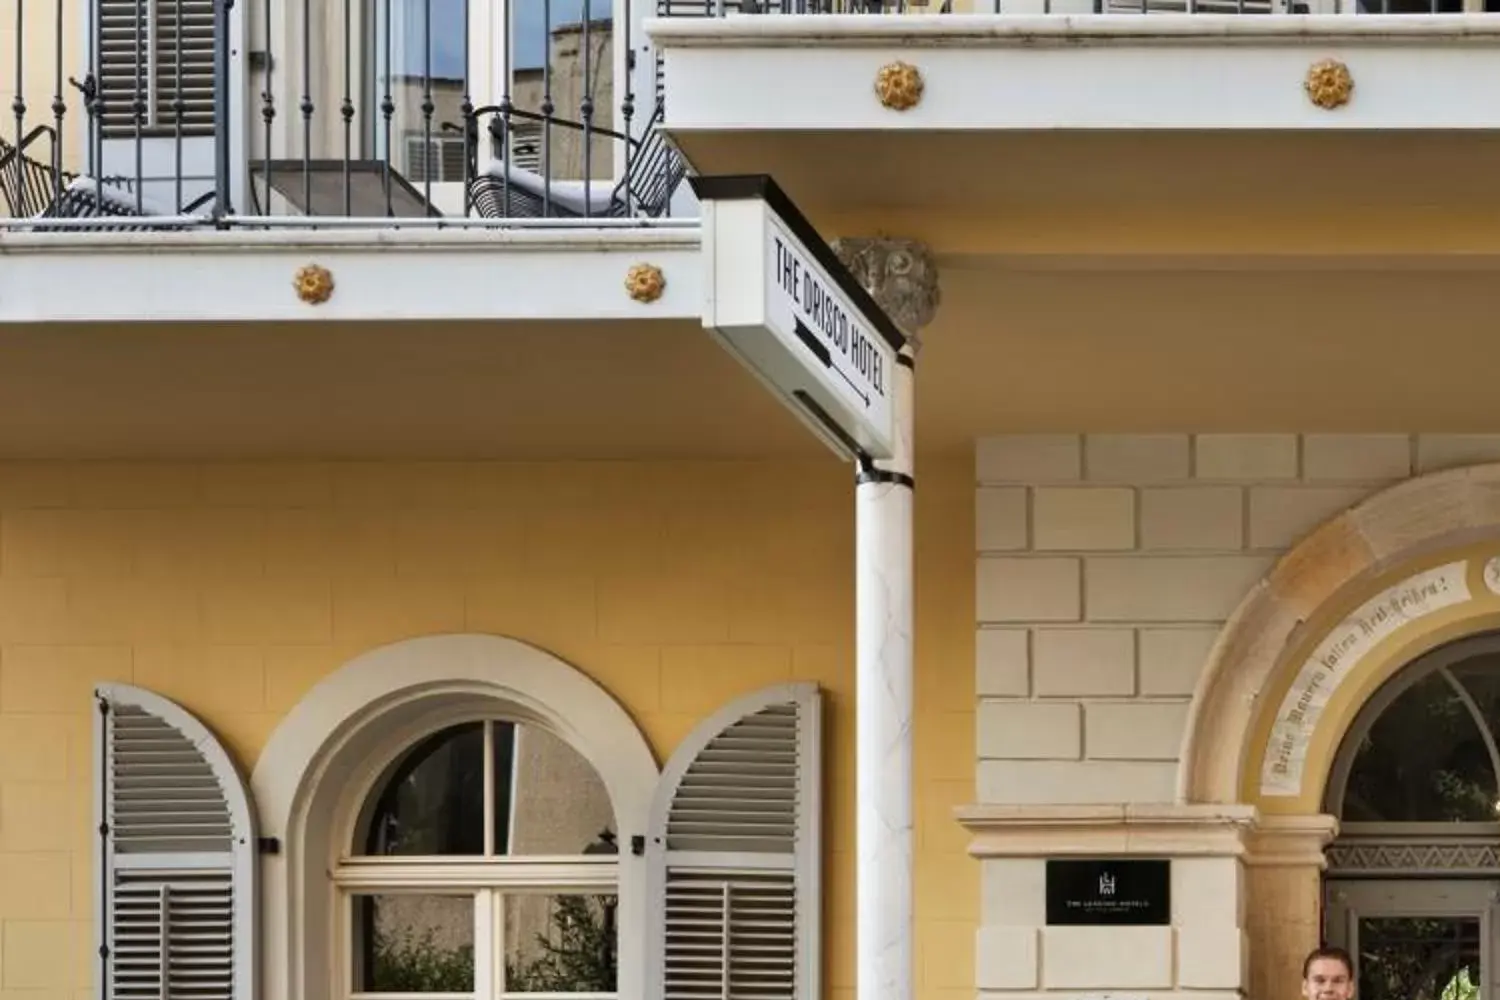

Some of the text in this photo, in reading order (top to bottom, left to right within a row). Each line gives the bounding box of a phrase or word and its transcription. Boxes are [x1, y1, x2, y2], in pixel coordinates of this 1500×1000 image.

[775, 237, 884, 396] THE DRISCO HOTEL
